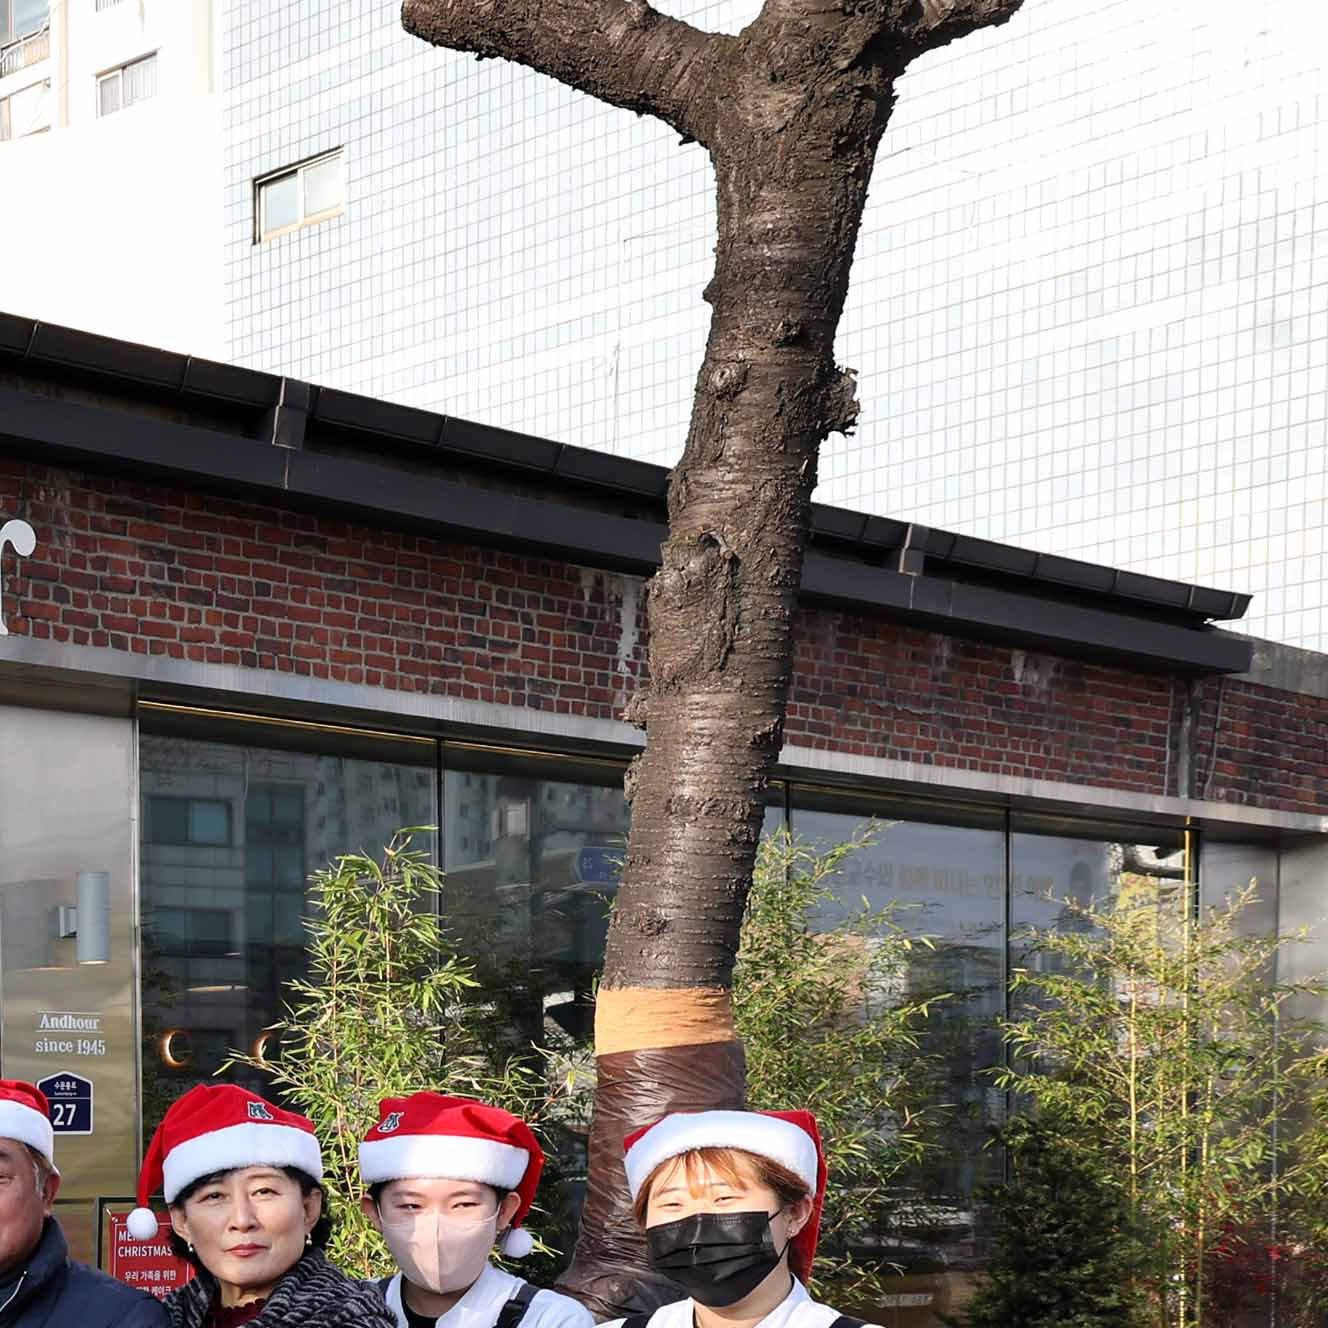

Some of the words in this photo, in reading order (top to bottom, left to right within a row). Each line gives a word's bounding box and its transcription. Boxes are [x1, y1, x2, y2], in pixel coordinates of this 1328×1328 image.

[39, 1013, 101, 1030] Andhour
[35, 1038, 73, 1053] since
[77, 1039, 106, 1056] 1945
[52, 1103, 77, 1127] 27
[117, 1245, 174, 1258] CHRISTMAS
[124, 1270, 139, 1282] 우리
[140, 1269, 161, 1281] 가족을
[163, 1269, 177, 1281] 위한
